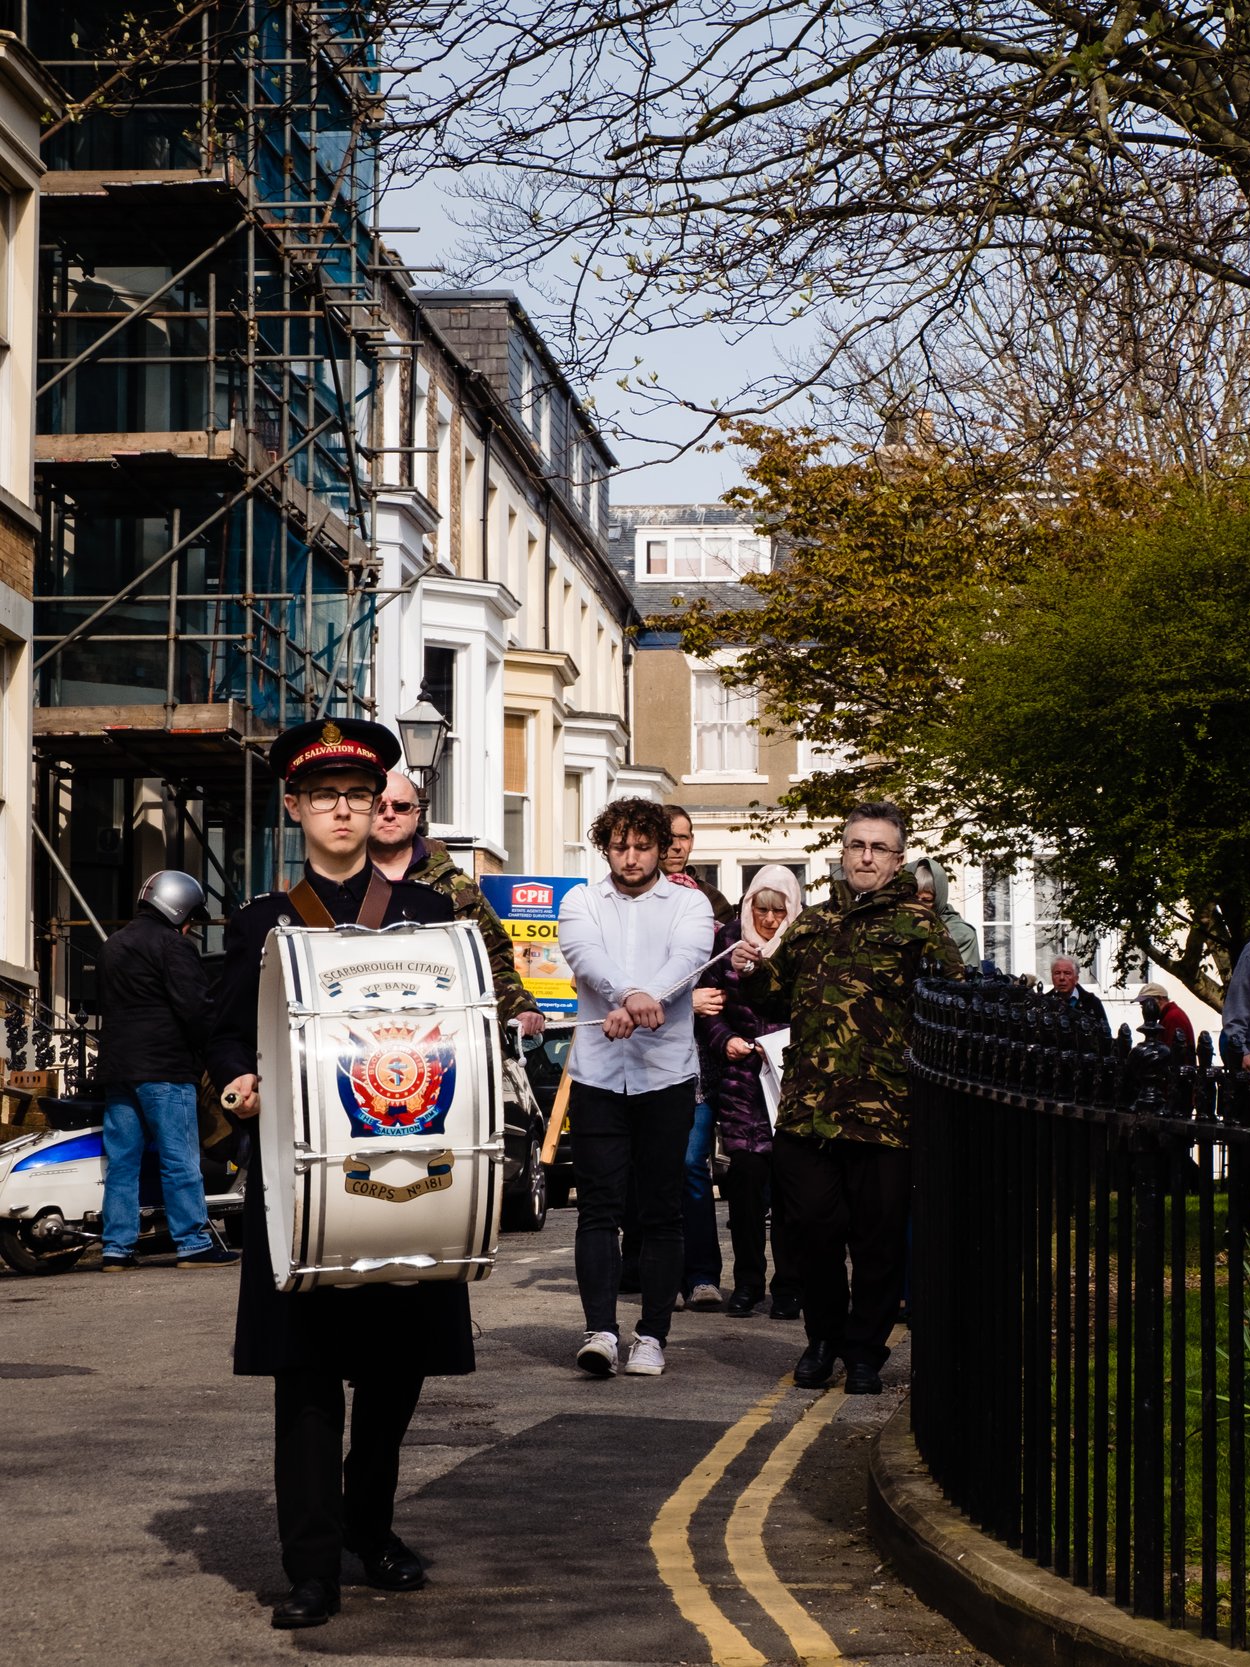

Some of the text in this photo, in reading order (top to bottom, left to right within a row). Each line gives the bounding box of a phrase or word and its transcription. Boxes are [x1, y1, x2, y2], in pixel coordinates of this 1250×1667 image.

[305, 745, 354, 760] SALVATION
[515, 889, 550, 903] CPH
[323, 961, 450, 982] SCARBOROUGH CITADEL
[385, 982, 416, 991] BAND
[359, 1111, 374, 1125] THE
[376, 1124, 420, 1135] SALVATION
[352, 1181, 395, 1200] CORPS
[425, 1177, 442, 1190] 181
